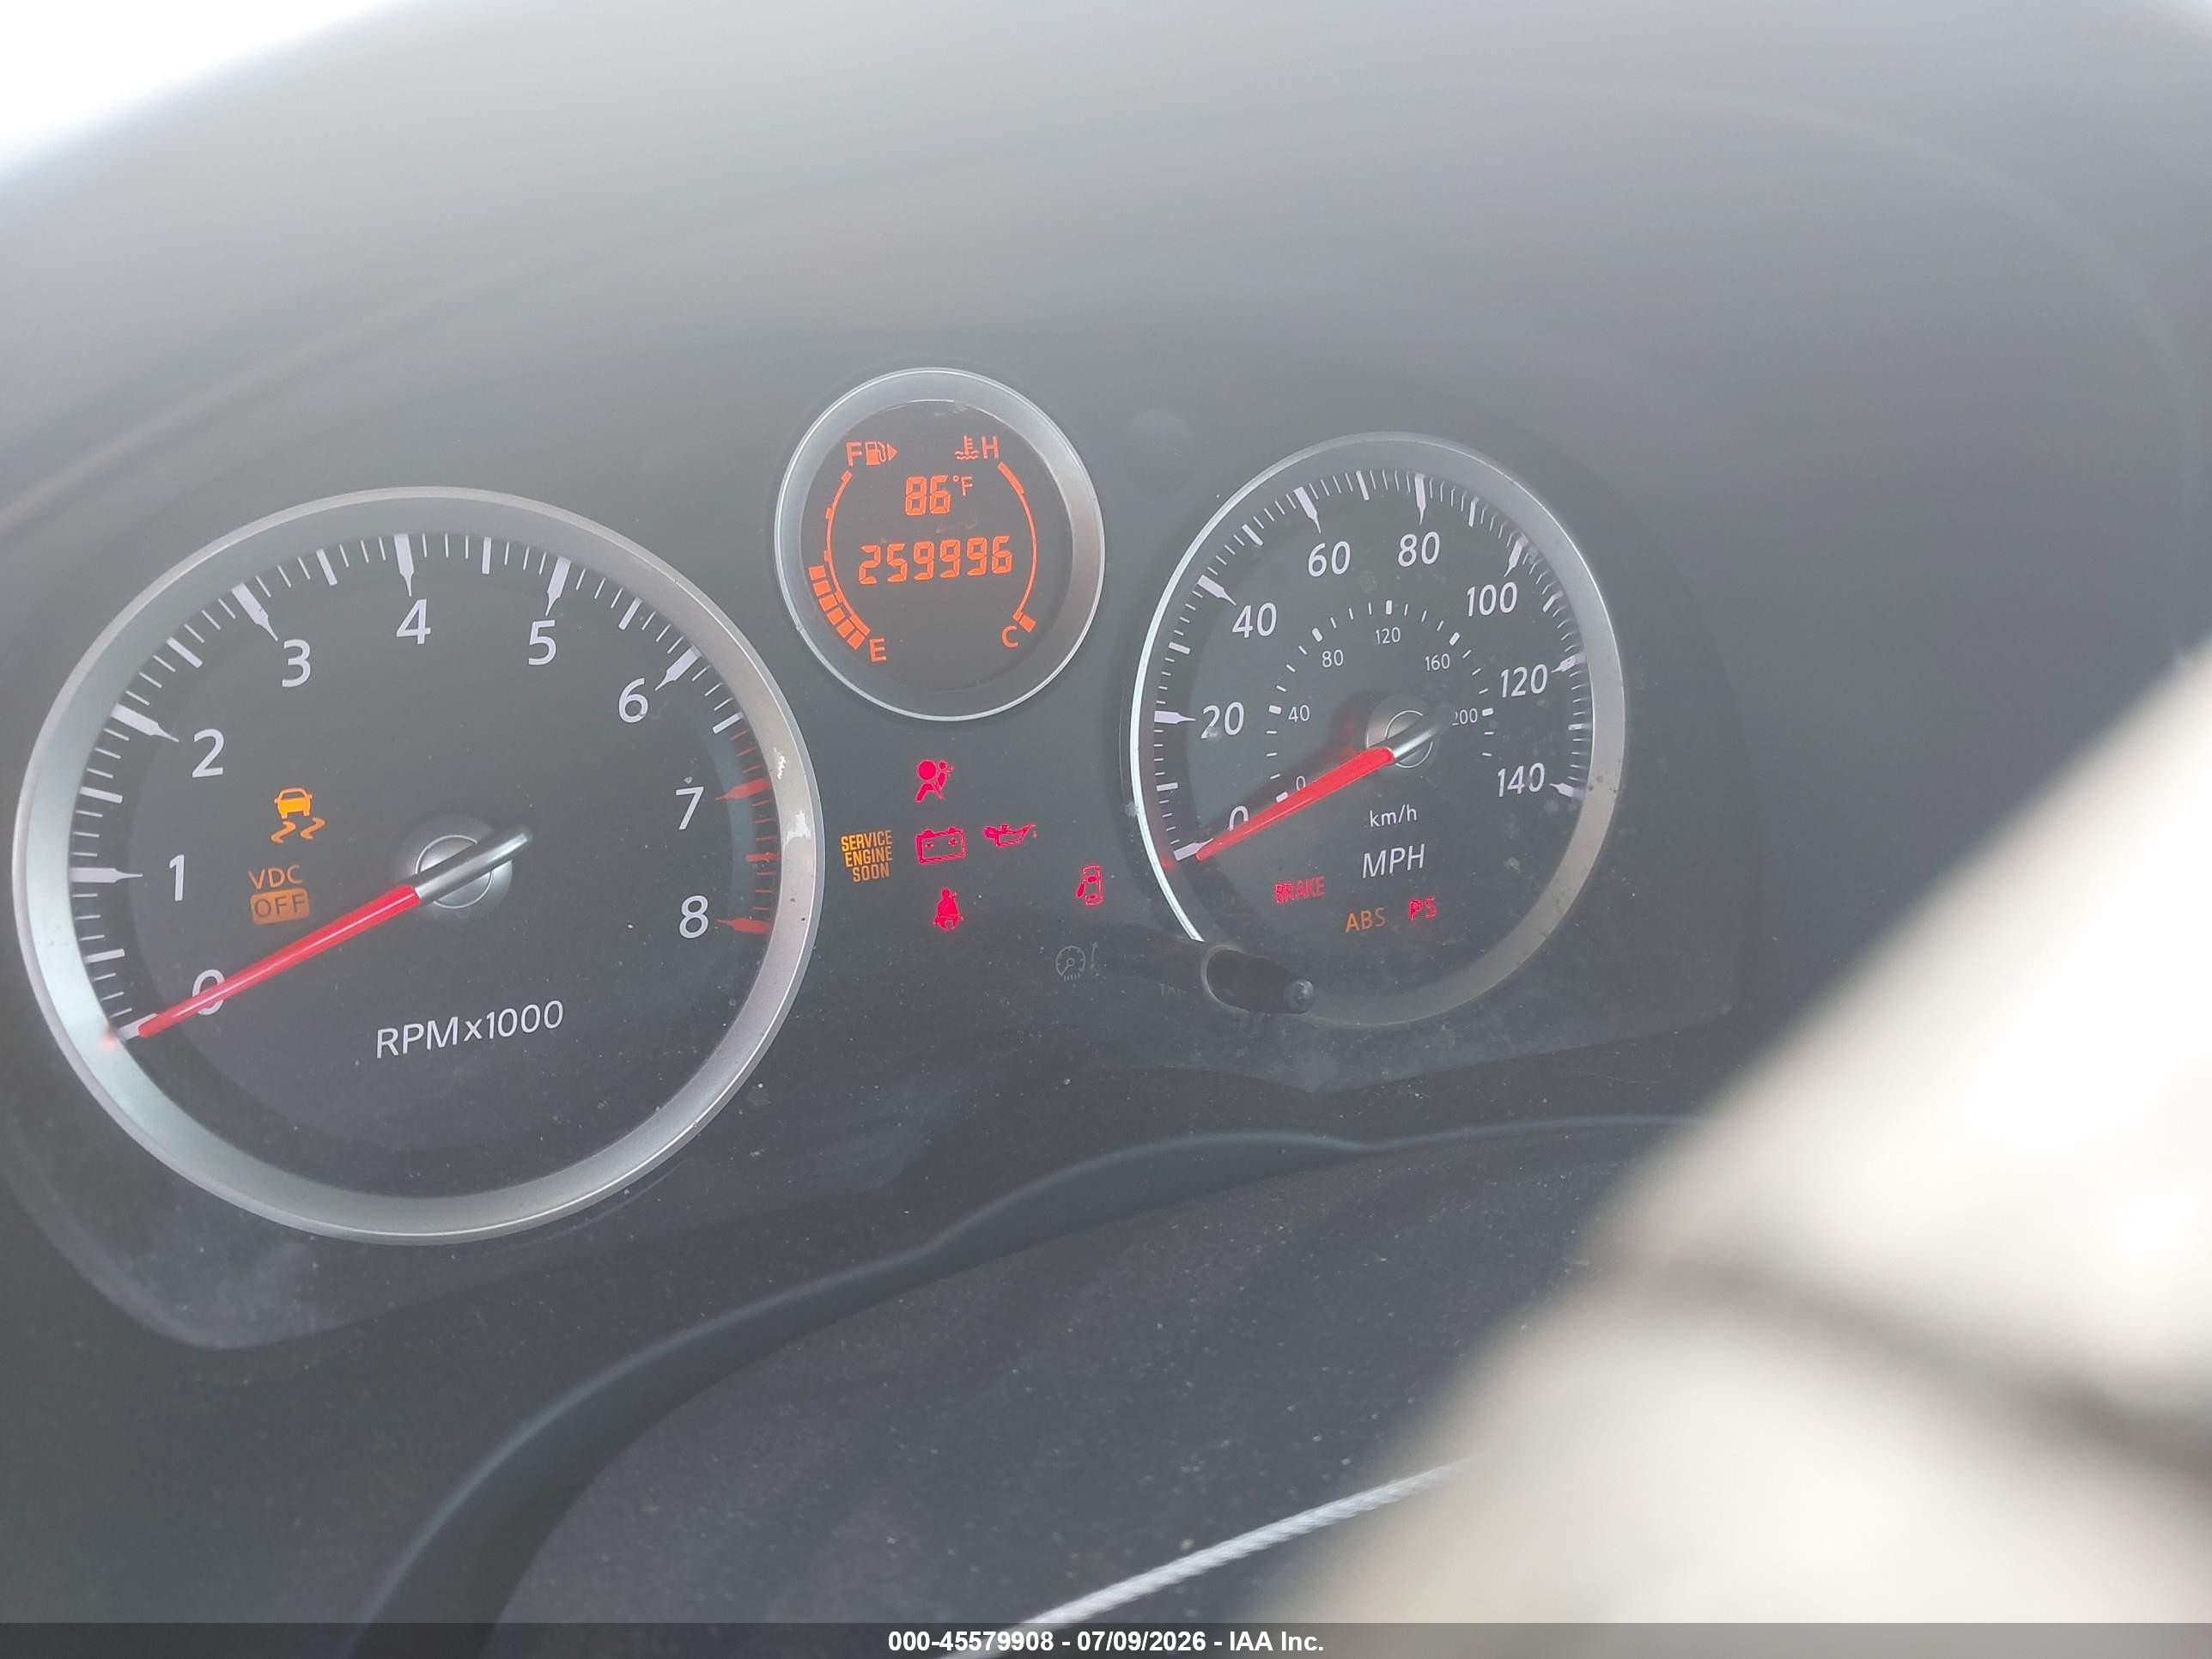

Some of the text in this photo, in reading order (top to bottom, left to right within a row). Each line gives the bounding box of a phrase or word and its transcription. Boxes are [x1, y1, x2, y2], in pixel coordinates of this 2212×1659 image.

[846, 441, 862, 466] F
[981, 436, 999, 459] H
[860, 536, 1012, 584] 259996
[1309, 542, 1350, 576] 60
[1399, 532, 1439, 566] 80
[1468, 582, 1516, 616] 100
[397, 599, 430, 644] 4
[1231, 603, 1277, 638] 40
[1376, 627, 1400, 643] 120
[529, 620, 556, 665] 5
[869, 638, 887, 662] E
[1001, 625, 1018, 647] C
[283, 640, 310, 687] 3
[1322, 650, 1343, 667] 80
[1425, 654, 1449, 671] 160
[1501, 665, 1547, 697] 120
[619, 678, 647, 722] 6
[1289, 705, 1310, 721] 40
[1201, 702, 1243, 738] 20
[192, 729, 223, 777] 2
[1296, 775, 1306, 791] 0
[1498, 763, 1544, 797] 140
[676, 787, 703, 830] 7
[1370, 805, 1416, 827] km/h
[841, 830, 893, 852] SERVICE
[844, 846, 893, 867] ENGINE
[1364, 844, 1424, 878] MPH
[170, 855, 184, 901] 1
[248, 865, 303, 890] VDC
[852, 861, 890, 883] SOON
[1275, 876, 1325, 904] BRAKE
[254, 894, 306, 918] OFF
[680, 896, 708, 938] 8
[1345, 908, 1386, 933] ABS
[1408, 896, 1437, 921] PS
[192, 969, 225, 1016] 0
